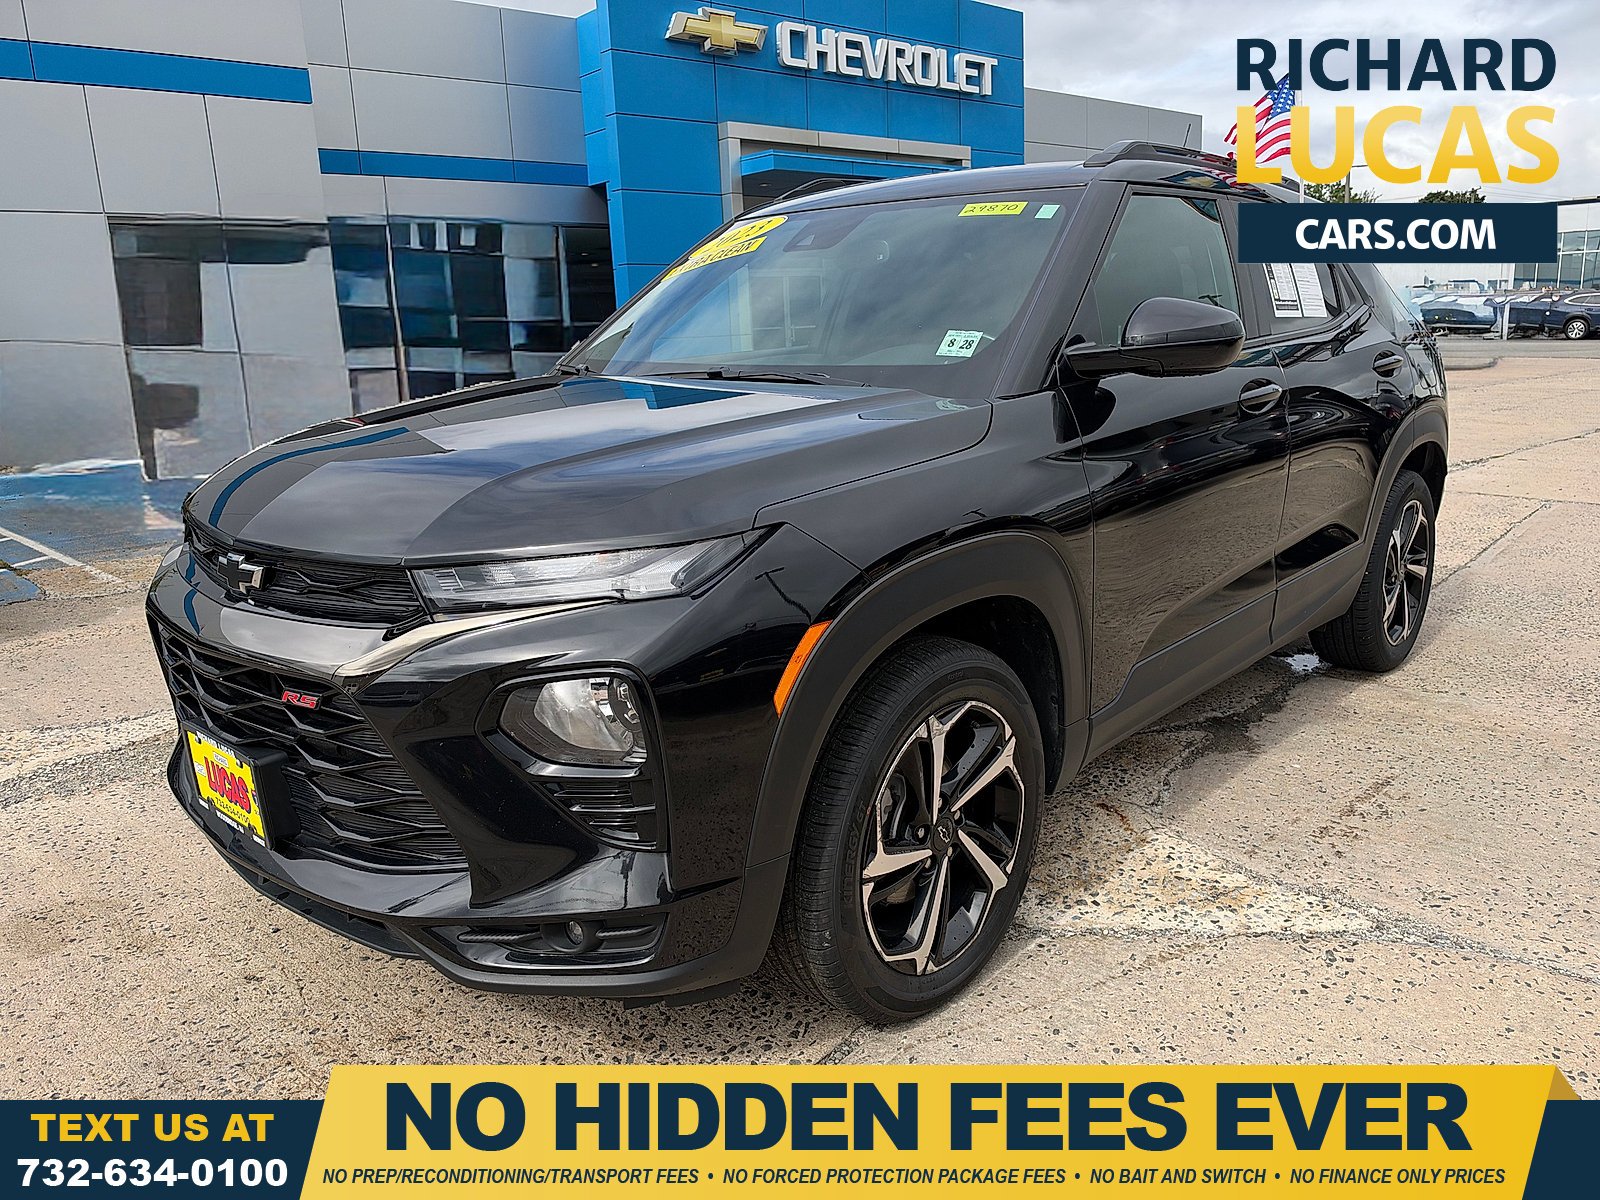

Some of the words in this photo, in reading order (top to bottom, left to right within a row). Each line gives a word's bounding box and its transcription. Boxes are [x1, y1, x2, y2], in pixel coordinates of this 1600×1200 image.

[776, 20, 998, 97] CHEVROLET
[947, 338, 957, 348] 8
[958, 339, 975, 350] 28
[281, 690, 319, 709] RS
[204, 756, 252, 815] LUCAS
